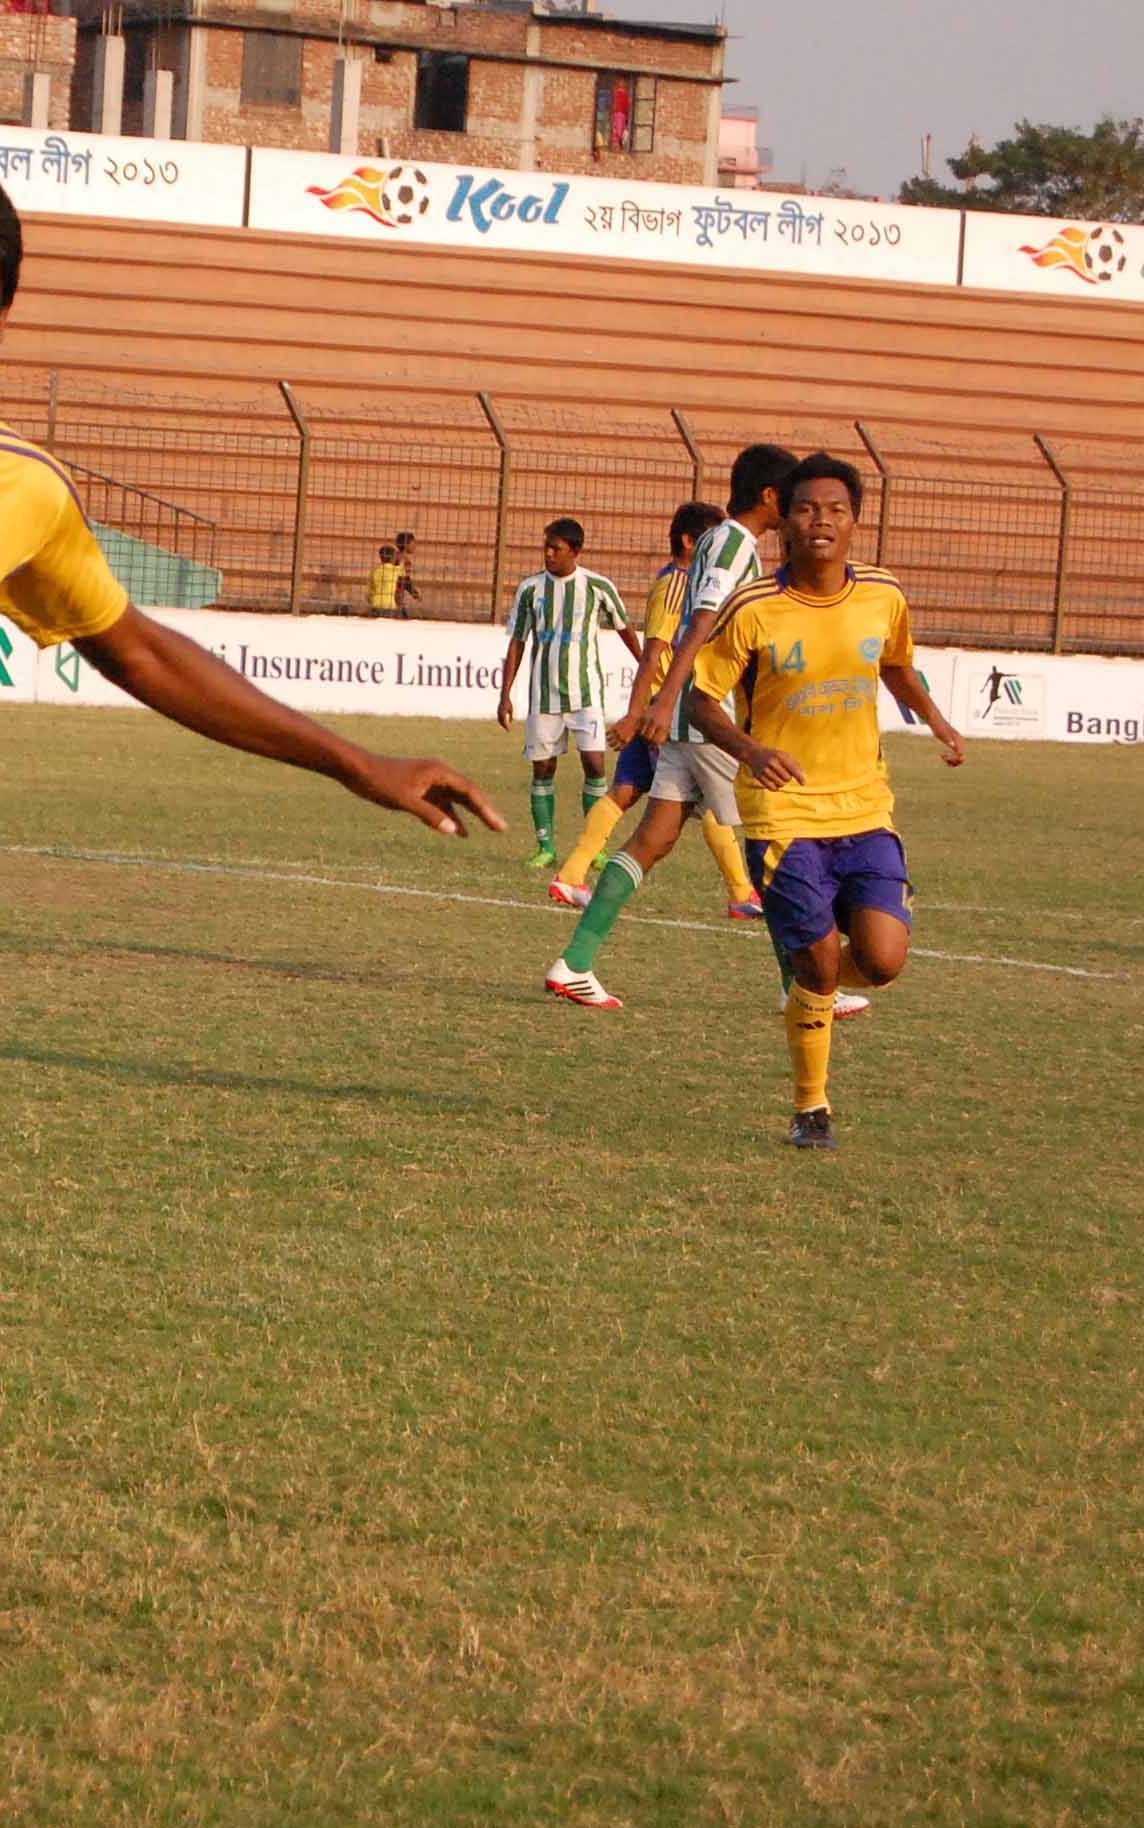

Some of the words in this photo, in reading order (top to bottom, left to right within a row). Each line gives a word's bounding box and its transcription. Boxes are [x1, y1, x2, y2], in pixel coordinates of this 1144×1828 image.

[40, 135, 93, 185] লীগ
[104, 156, 179, 185] ২০১৩
[446, 174, 570, 234] Kool
[621, 199, 682, 236] বিভাগ
[691, 195, 771, 248] ফুটবল
[777, 199, 825, 245] লীগ
[834, 219, 901, 246] ২০১৩
[239, 644, 385, 685] Insurance
[394, 652, 508, 690] Limited
[767, 639, 806, 674] 14
[1066, 710, 1144, 742] Bang
